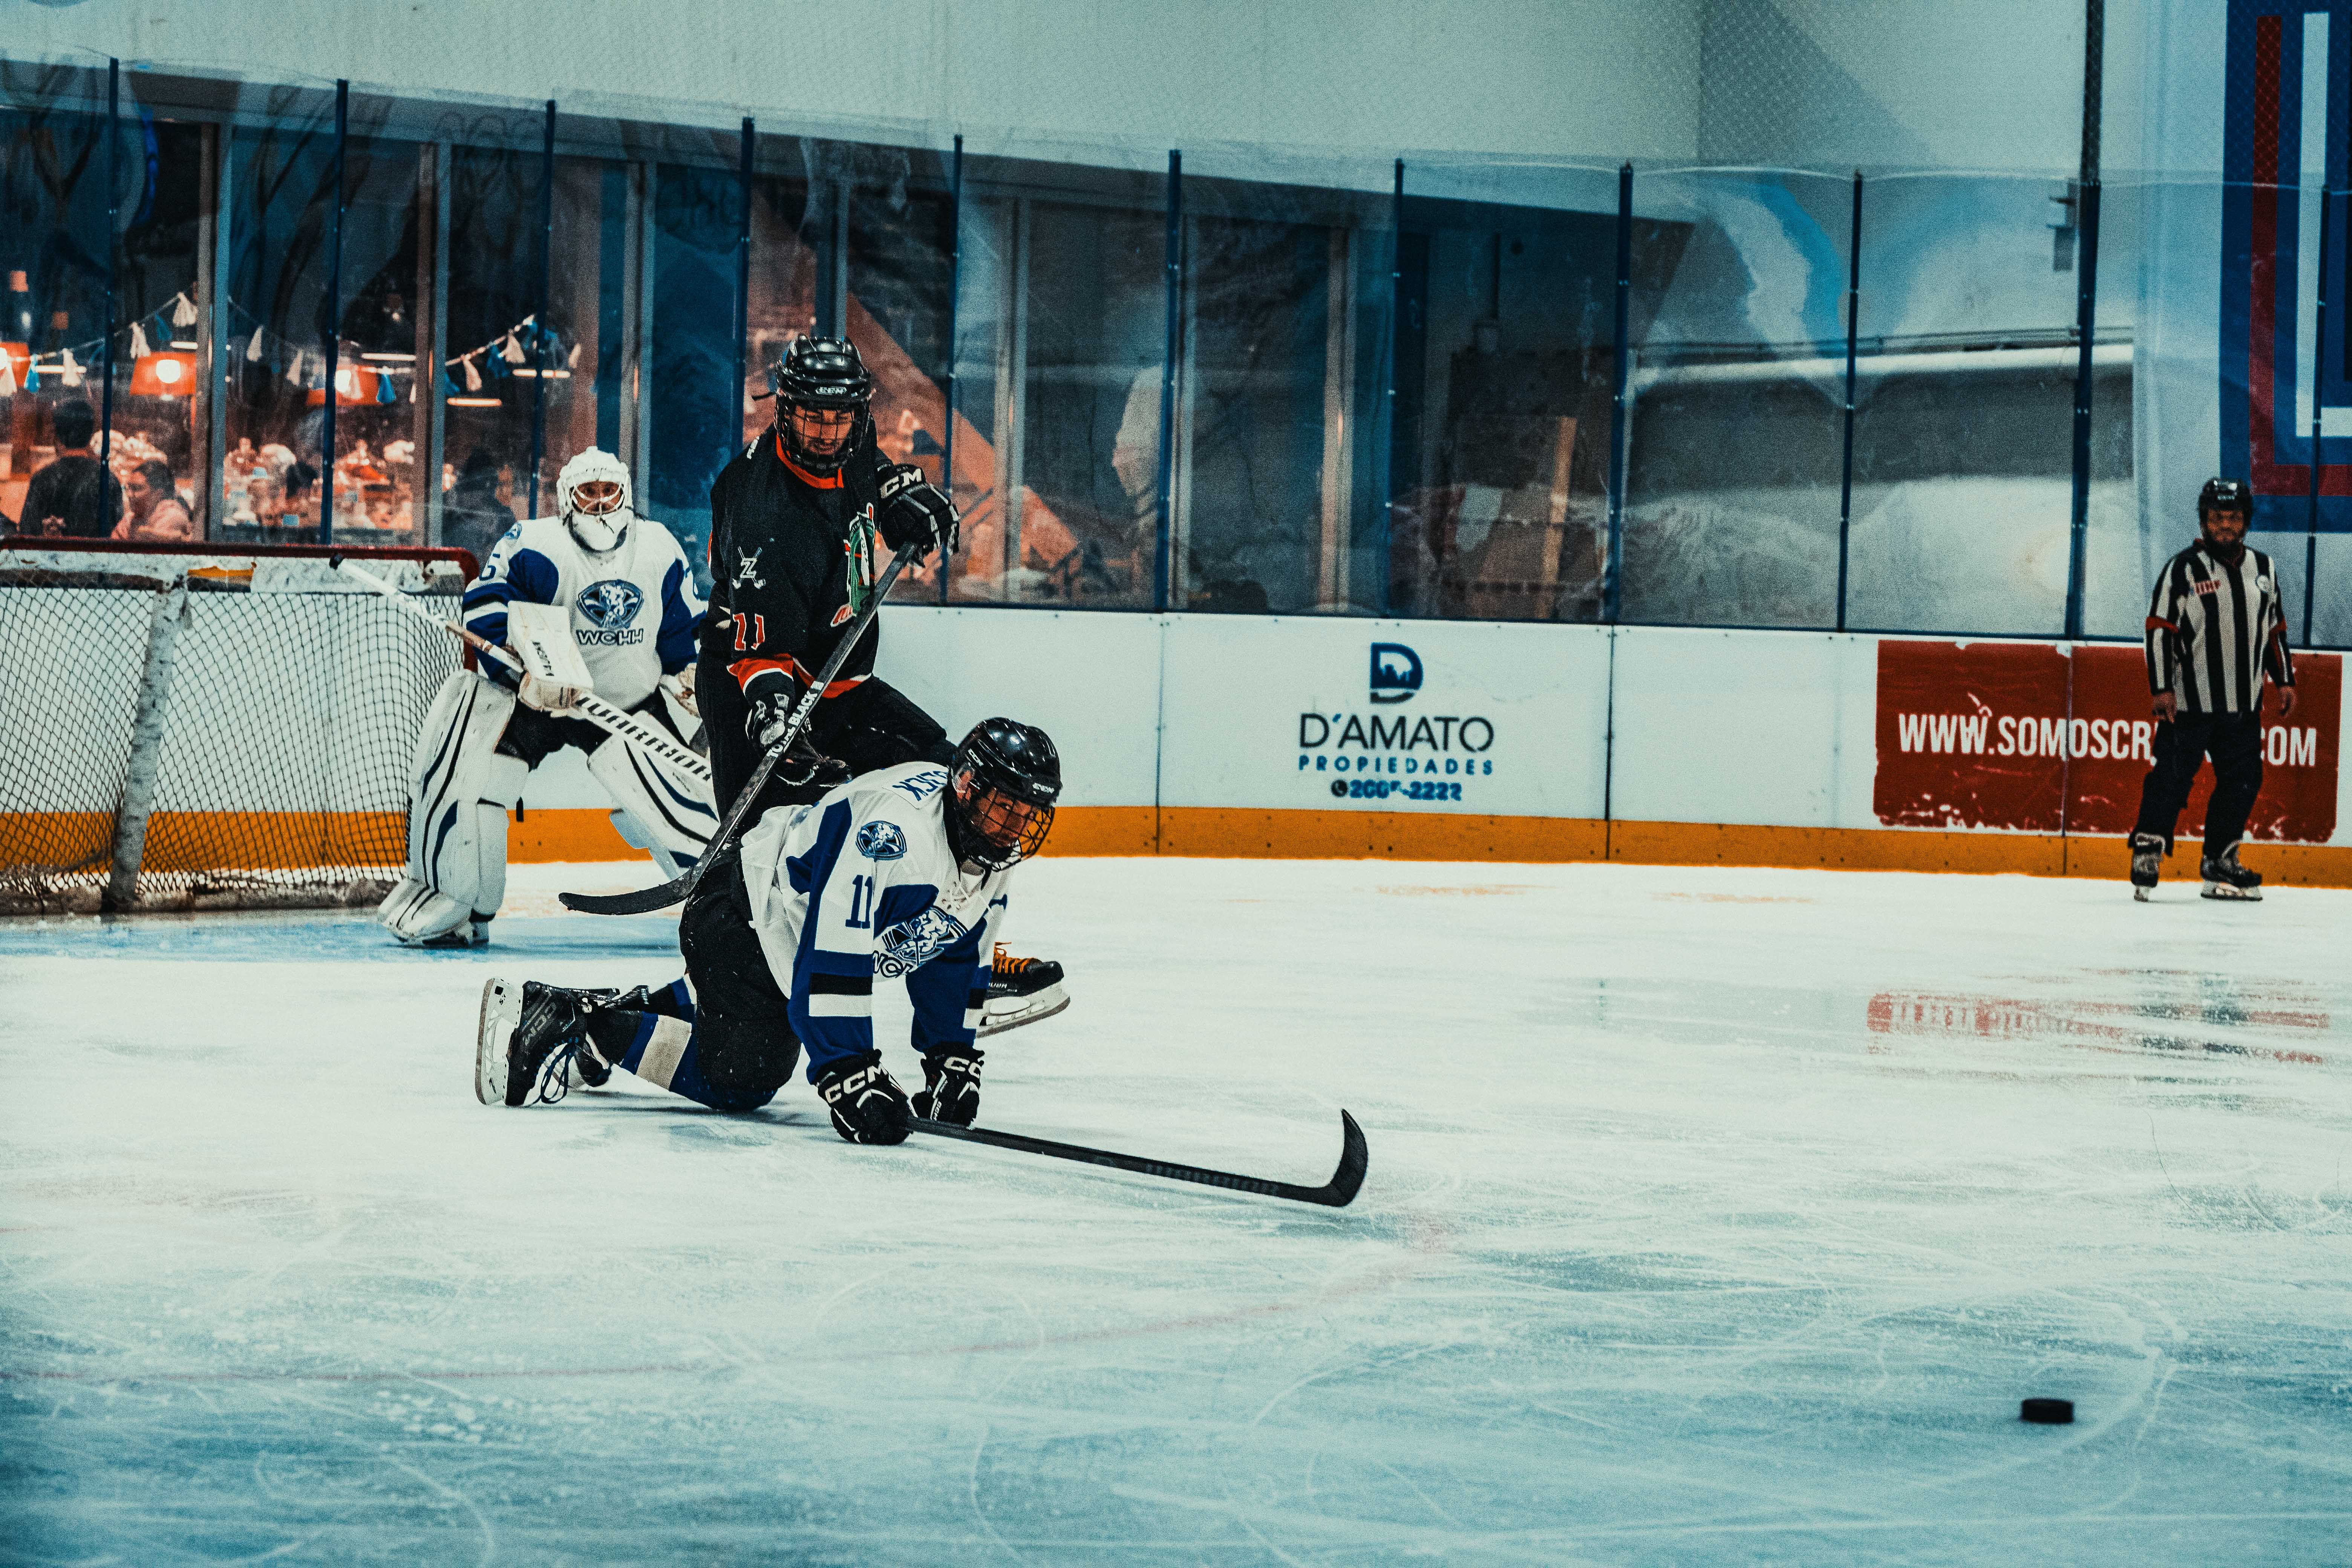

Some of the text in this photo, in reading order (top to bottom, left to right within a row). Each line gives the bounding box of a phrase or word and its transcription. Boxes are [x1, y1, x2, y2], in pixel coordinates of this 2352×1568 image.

[576, 628, 643, 646] WCHH
[788, 691, 818, 726] BLACK
[1298, 755, 1493, 776] PROPIEDADES
[845, 874, 873, 929] 11
[825, 1063, 889, 1104] CCM
